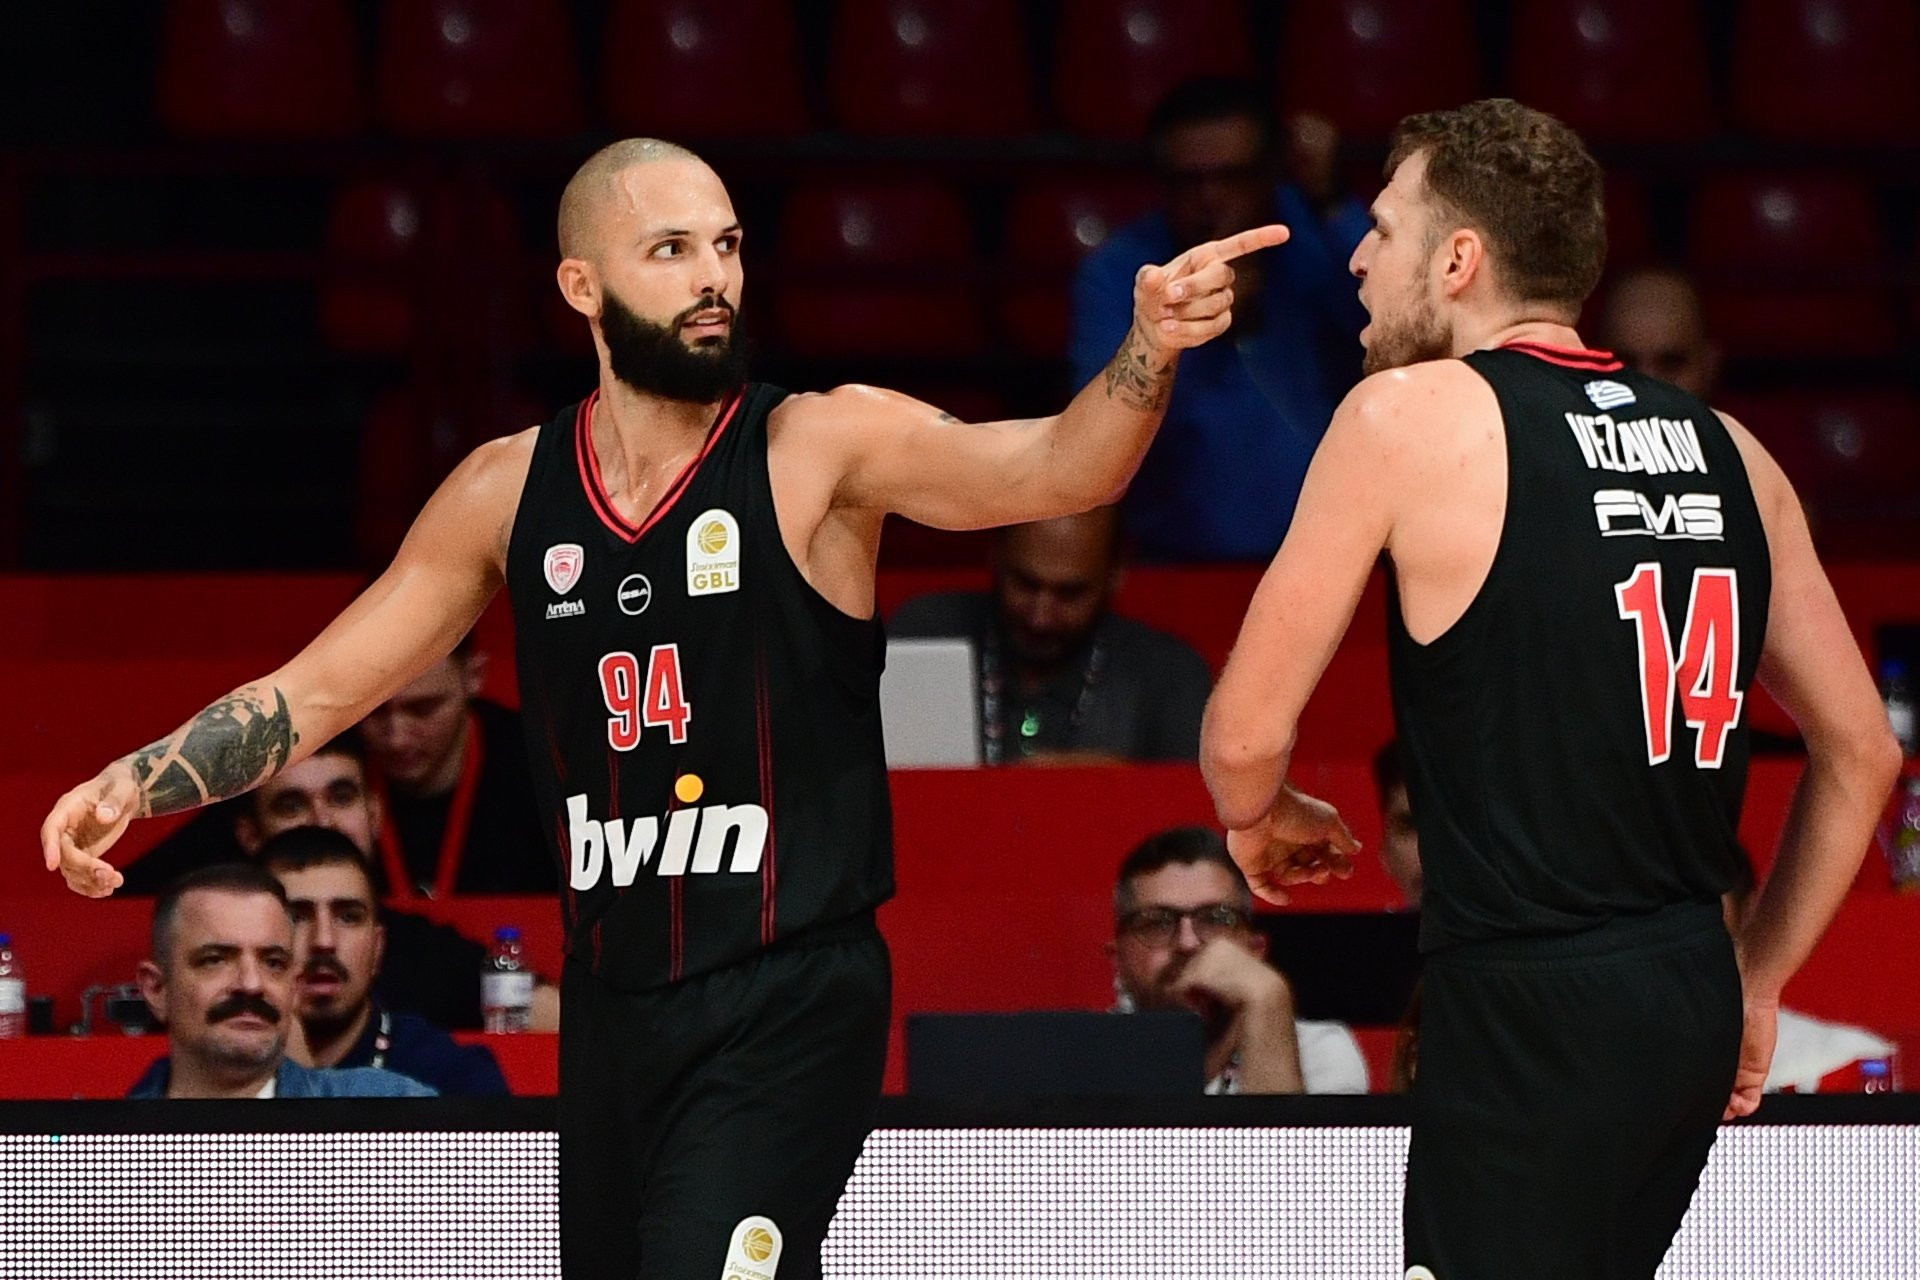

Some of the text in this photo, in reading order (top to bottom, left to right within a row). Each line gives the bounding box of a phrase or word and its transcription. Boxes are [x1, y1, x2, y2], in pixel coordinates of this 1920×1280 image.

[1593, 489, 1724, 541] FMS
[693, 570, 735, 590] GBL
[598, 643, 691, 751] 94
[1614, 562, 1744, 769] 14
[566, 774, 769, 891] bwin
